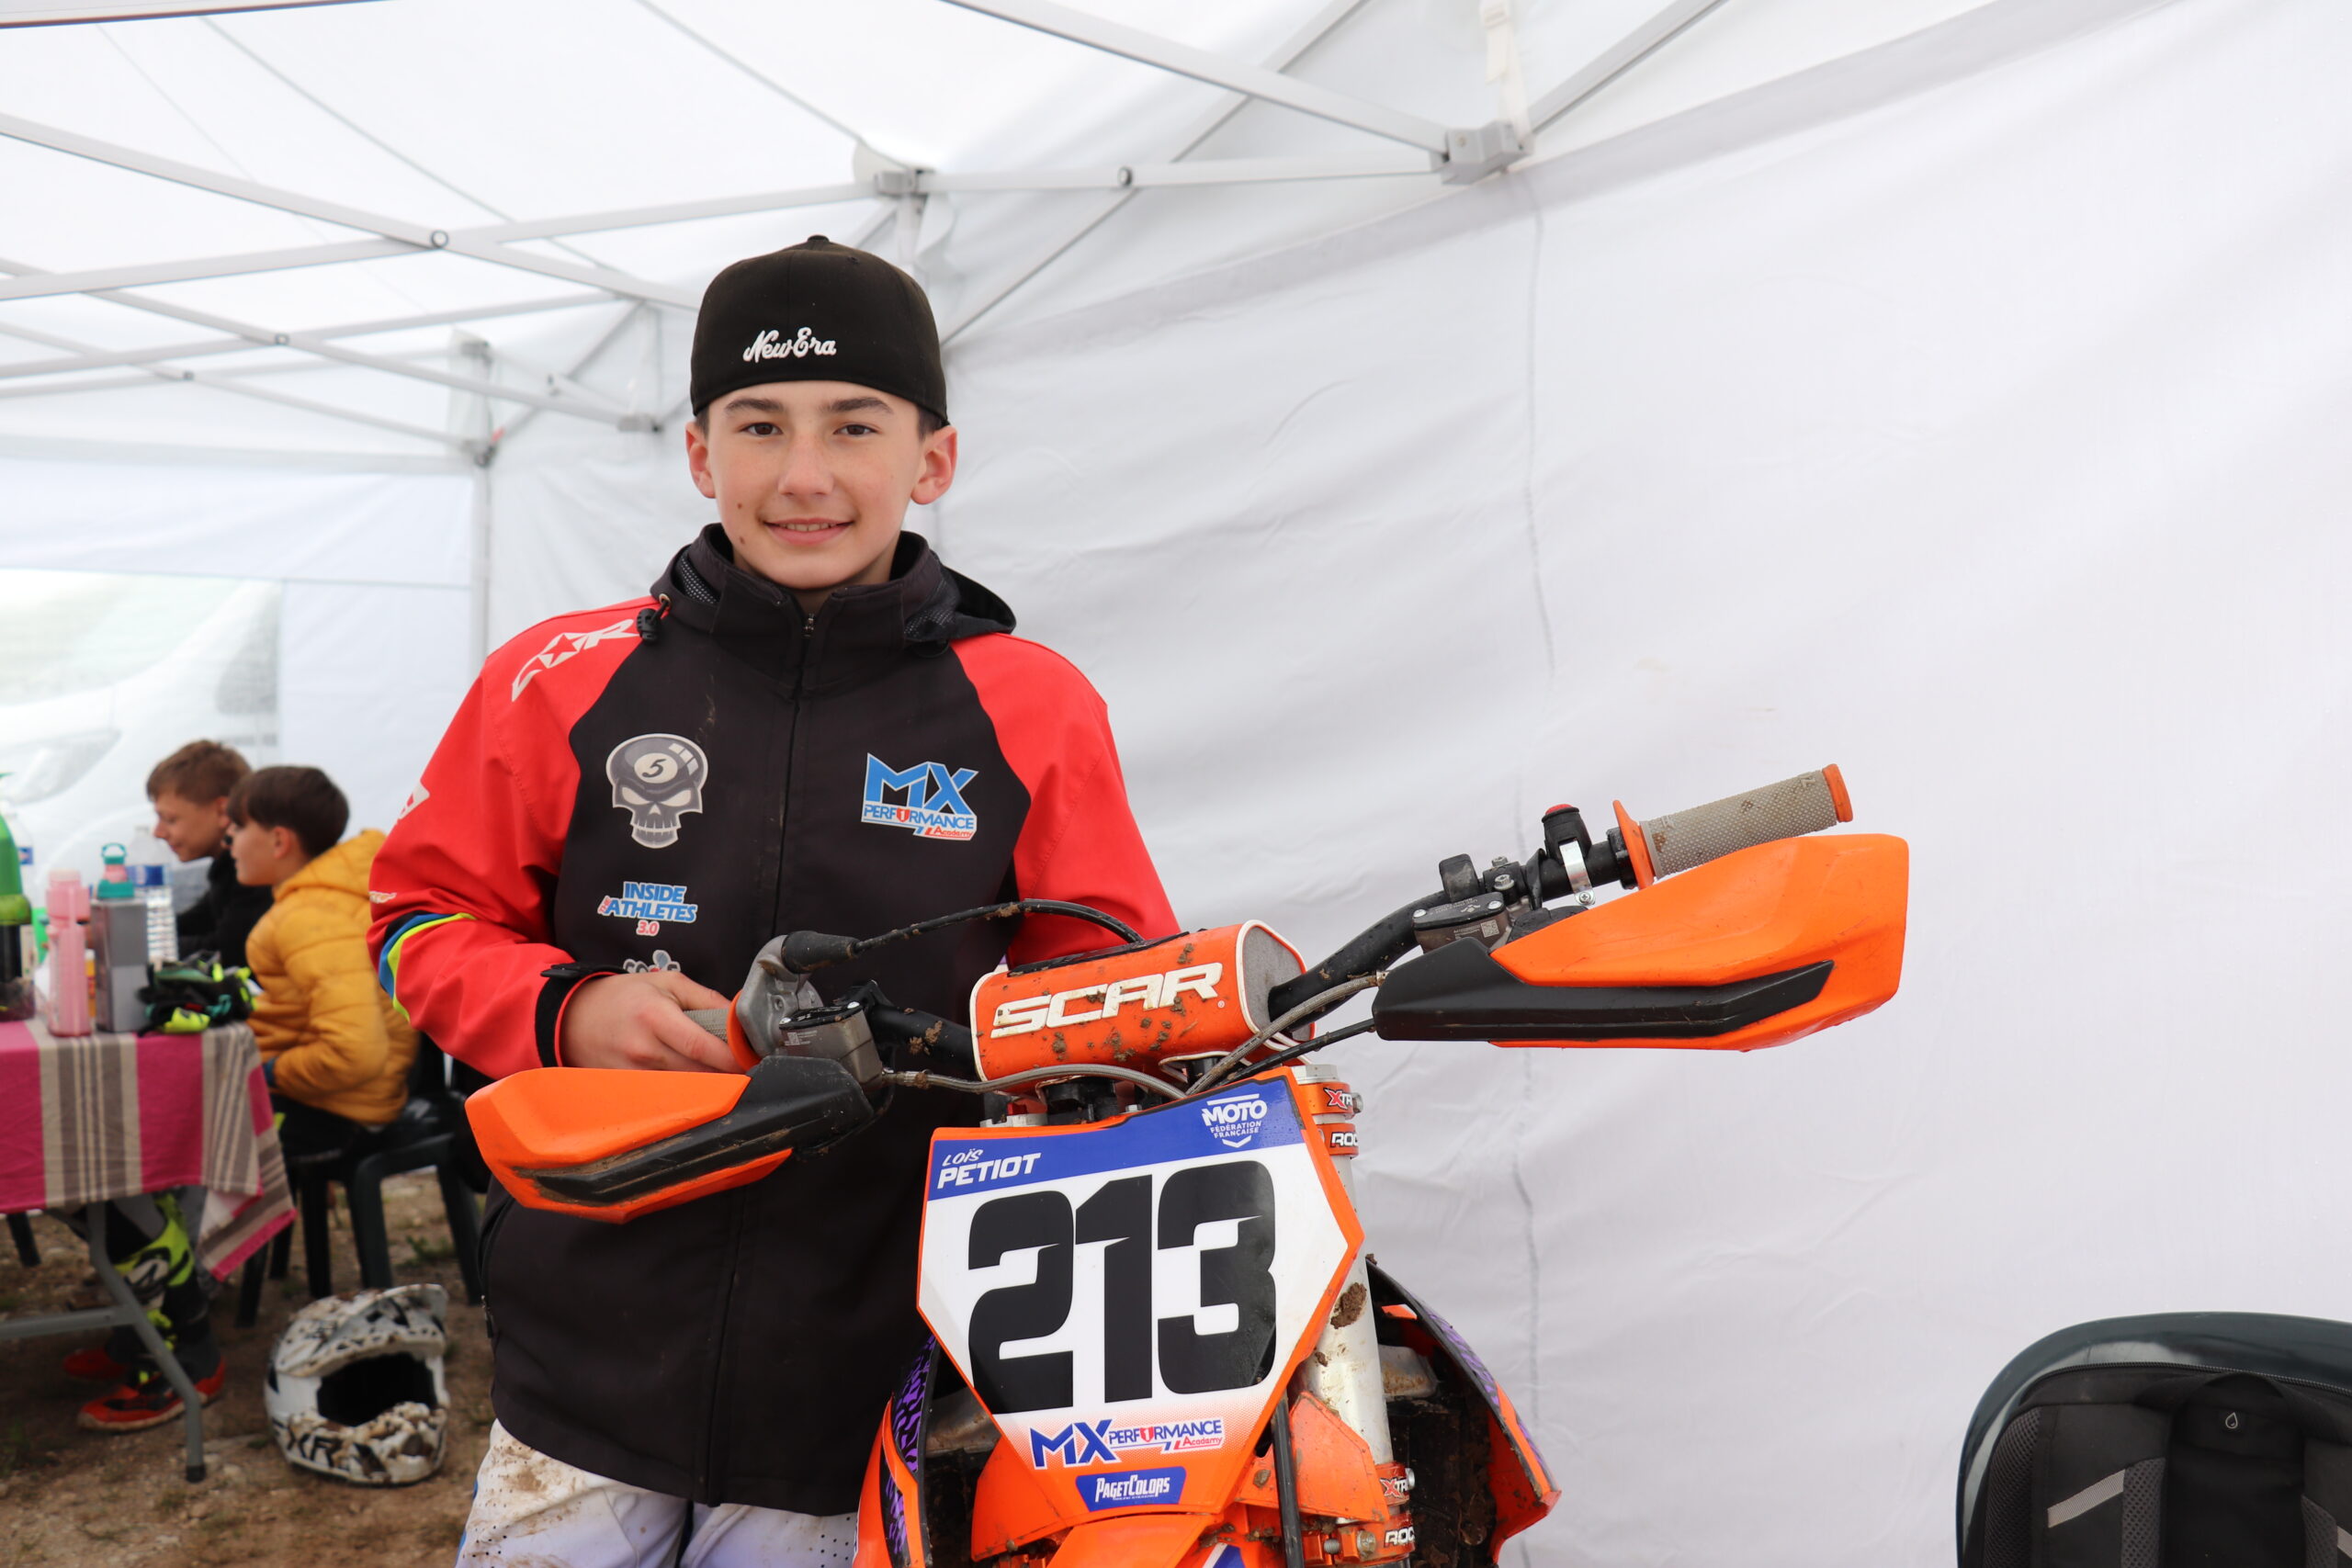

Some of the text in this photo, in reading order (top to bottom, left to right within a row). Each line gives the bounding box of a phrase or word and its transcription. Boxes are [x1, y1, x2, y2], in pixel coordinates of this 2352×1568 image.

[642, 760, 667, 778] 5
[865, 753, 978, 815] MX
[625, 883, 686, 903] INSIDE
[605, 899, 696, 921] ATHLETES
[638, 920, 660, 934] 3.0
[990, 963, 1223, 1039] SCAR
[1202, 1100, 1268, 1126] MOTO
[1210, 1121, 1262, 1134] FÉDÉRATION
[1214, 1127, 1260, 1139] FRANÇAISE
[942, 1148, 984, 1167] LOÏS
[937, 1153, 1042, 1189] PETIOT
[968, 1160, 1276, 1415] 213
[1030, 1419, 1118, 1468] MX
[1183, 1436, 1223, 1447] Academy
